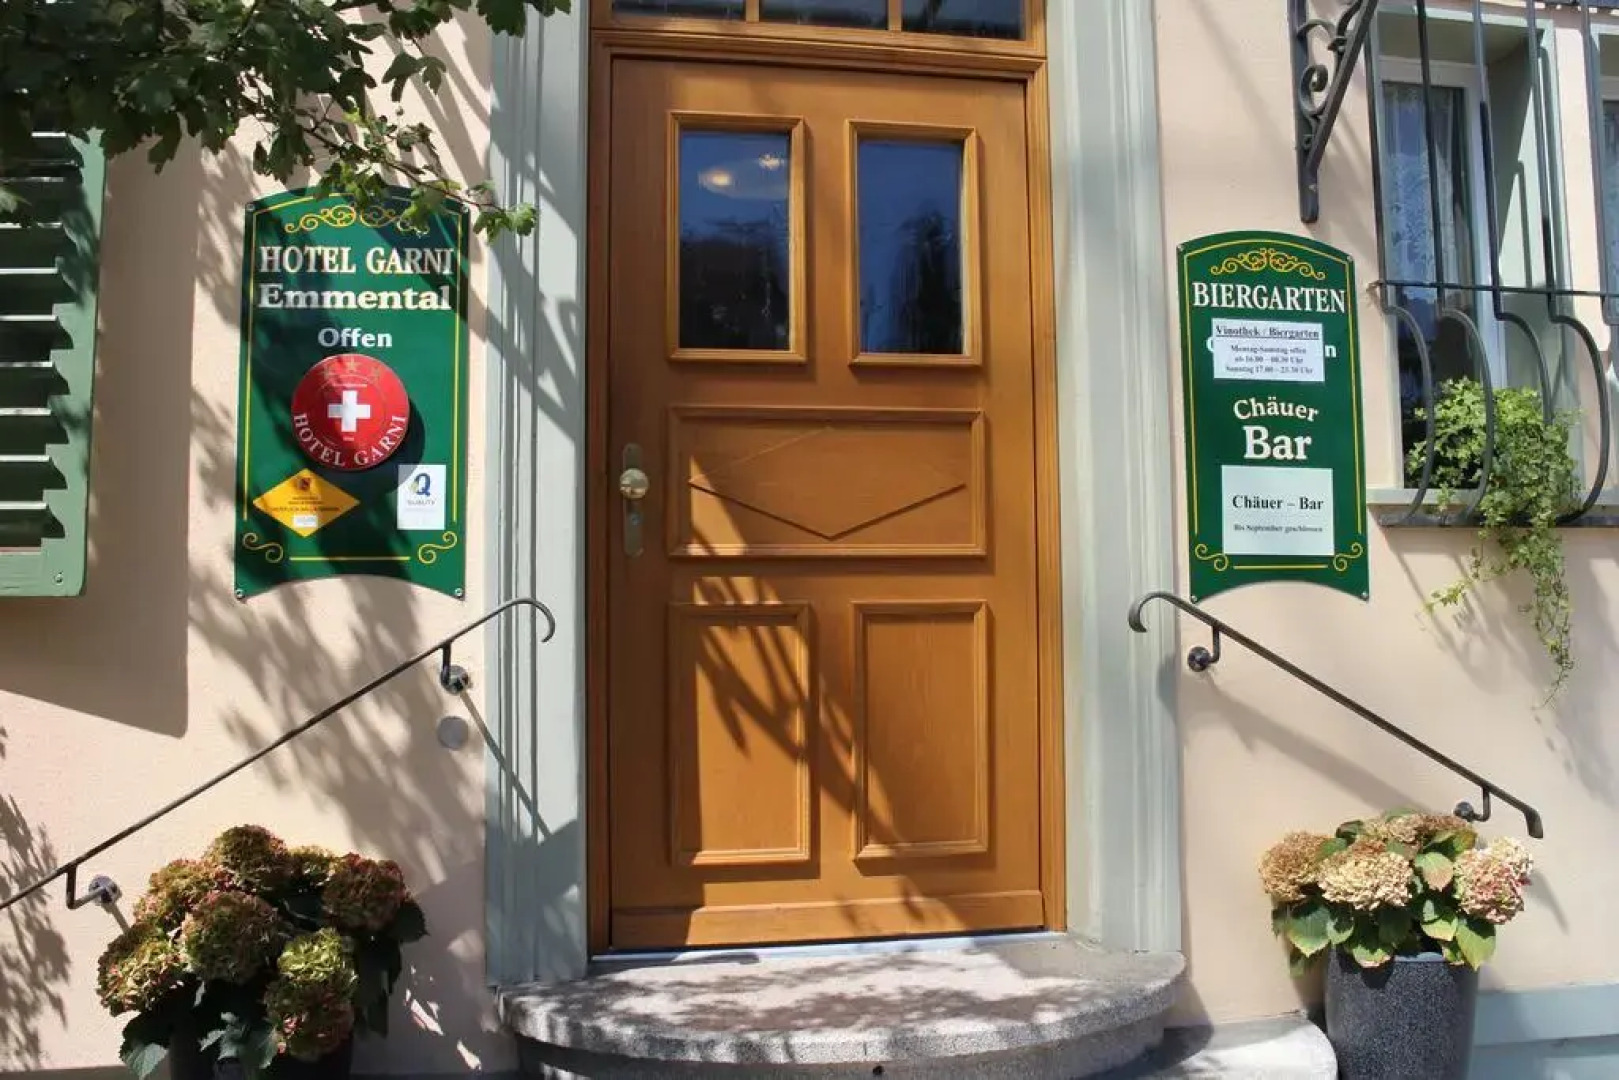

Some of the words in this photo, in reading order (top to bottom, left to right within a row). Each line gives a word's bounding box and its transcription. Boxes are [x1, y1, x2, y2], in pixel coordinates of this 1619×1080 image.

[258, 246, 357, 274] HOTEL
[364, 247, 455, 275] GARNI
[257, 282, 453, 310] Emmental
[1191, 281, 1346, 313] BIERGARTEN
[317, 327, 394, 348] Offen
[1215, 325, 1260, 337] Vinothek
[1269, 327, 1320, 340] Biergarten
[1233, 396, 1319, 422] Chäuer
[294, 412, 346, 467] HOTEL
[353, 415, 407, 466] GARNI
[1242, 425, 1312, 460] Bar
[414, 472, 431, 497] Q
[1232, 494, 1284, 509] Chäuer
[1299, 496, 1324, 510] Bar
